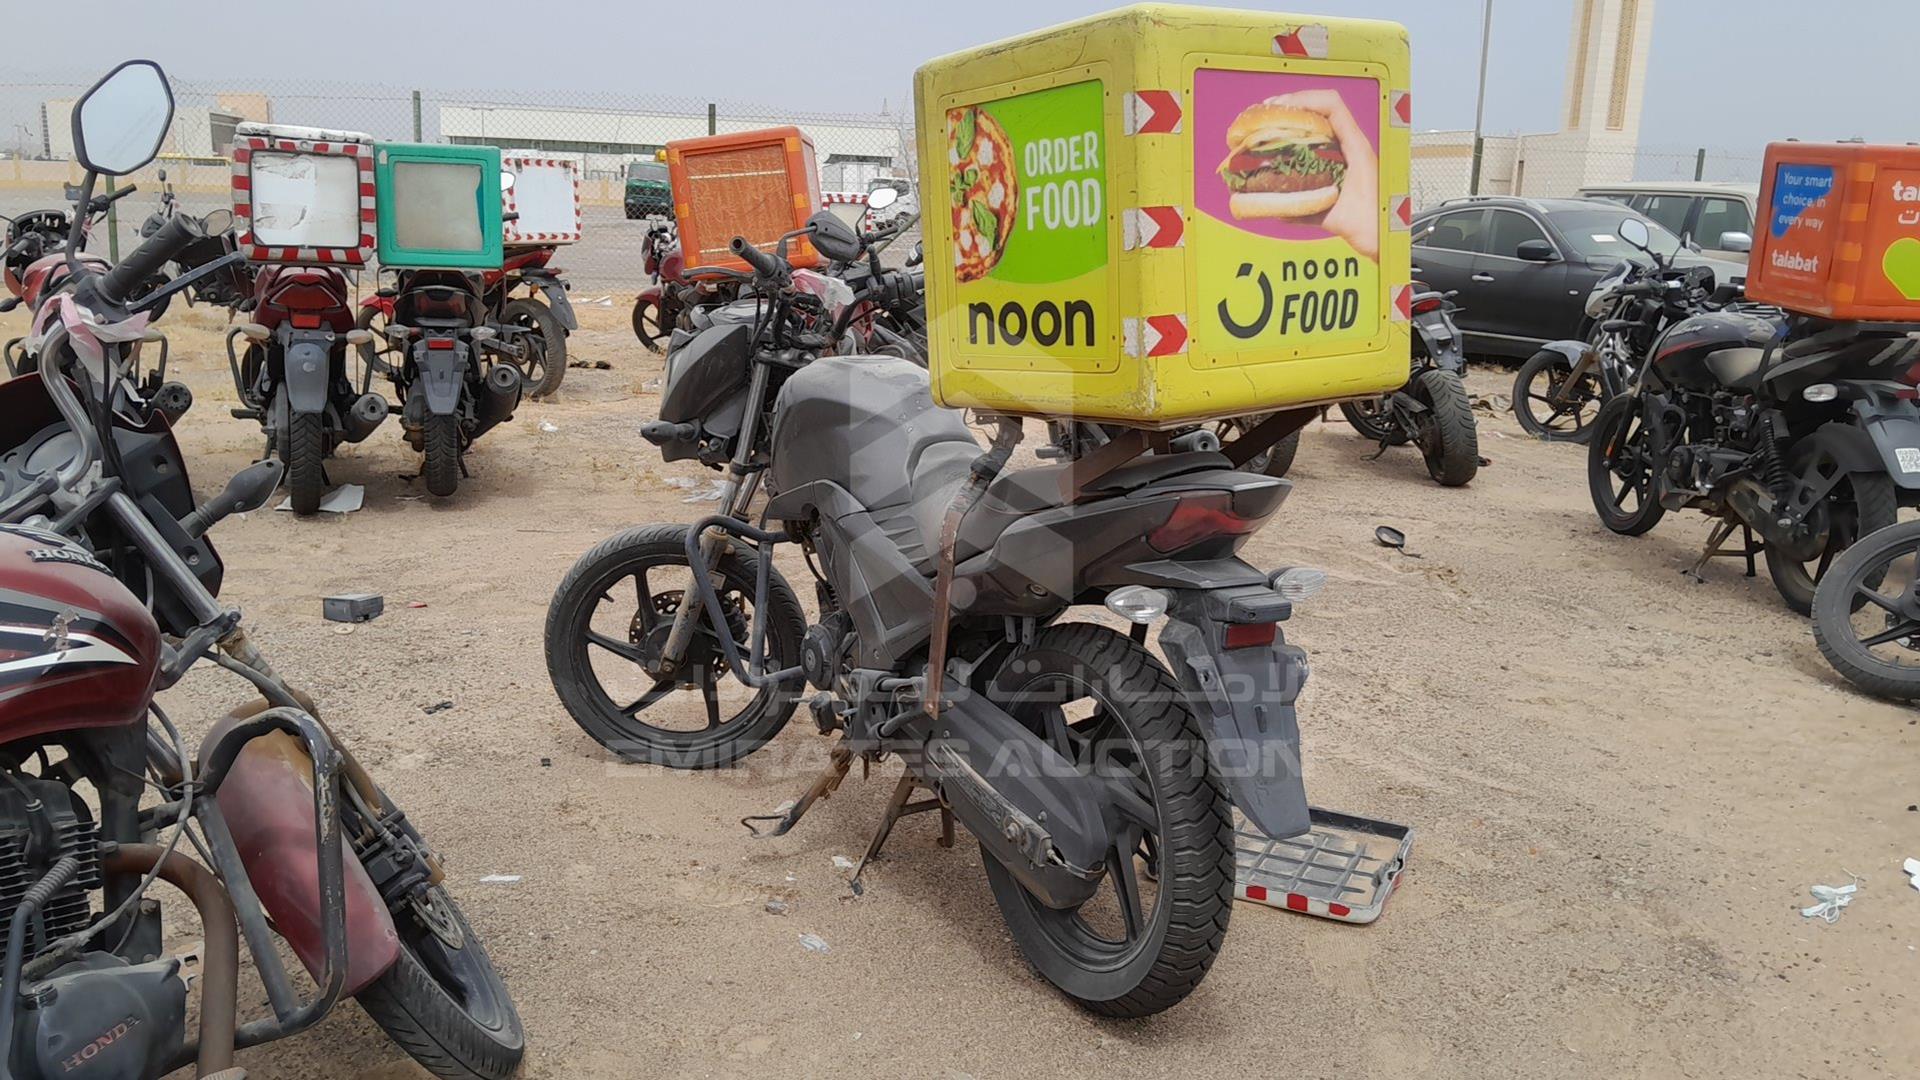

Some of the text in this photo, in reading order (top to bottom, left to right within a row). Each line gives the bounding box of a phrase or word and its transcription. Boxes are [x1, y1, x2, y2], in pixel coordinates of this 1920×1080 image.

[1024, 131, 1099, 178] ORDER
[1784, 171, 1832, 188] Your smart
[1026, 178, 1101, 231] FOOD
[1778, 214, 1825, 232] every way
[1282, 257, 1358, 281] noon
[1771, 249, 1818, 273] talabat
[968, 299, 1096, 347] noon
[1280, 288, 1359, 335] FOOD
